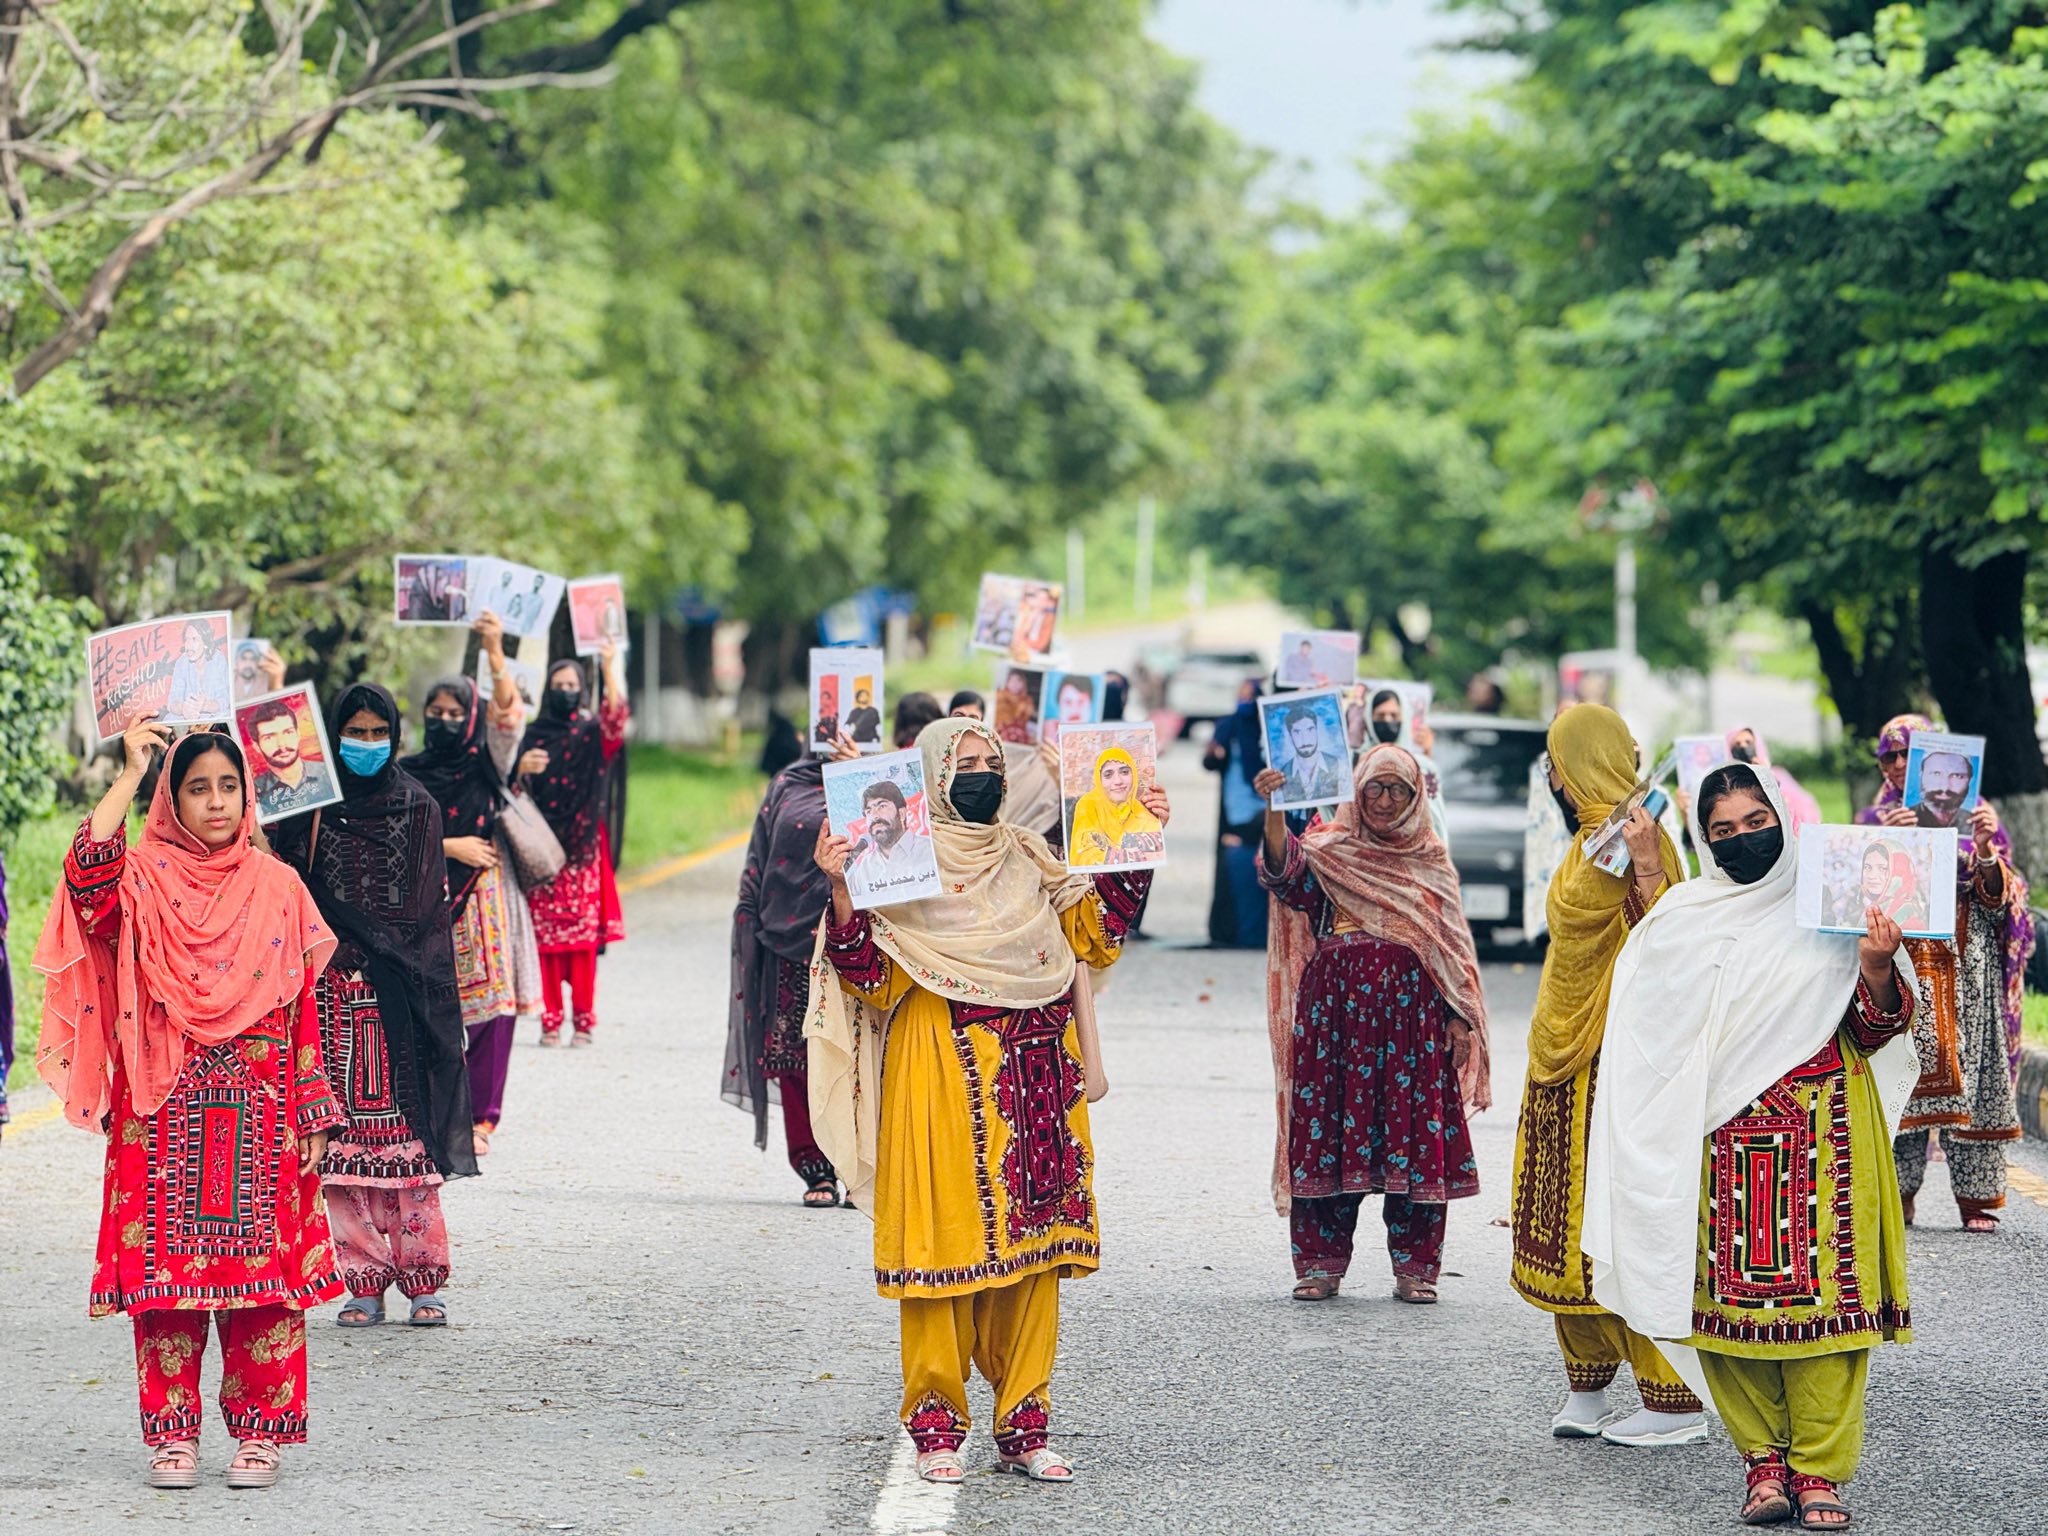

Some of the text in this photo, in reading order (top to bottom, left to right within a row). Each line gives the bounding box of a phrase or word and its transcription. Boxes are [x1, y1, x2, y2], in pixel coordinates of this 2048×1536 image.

[93, 624, 165, 694] #SAVE
[107, 662, 157, 709] RASHID
[108, 678, 166, 733] HUSSAIN
[889, 874, 915, 886] محمد
